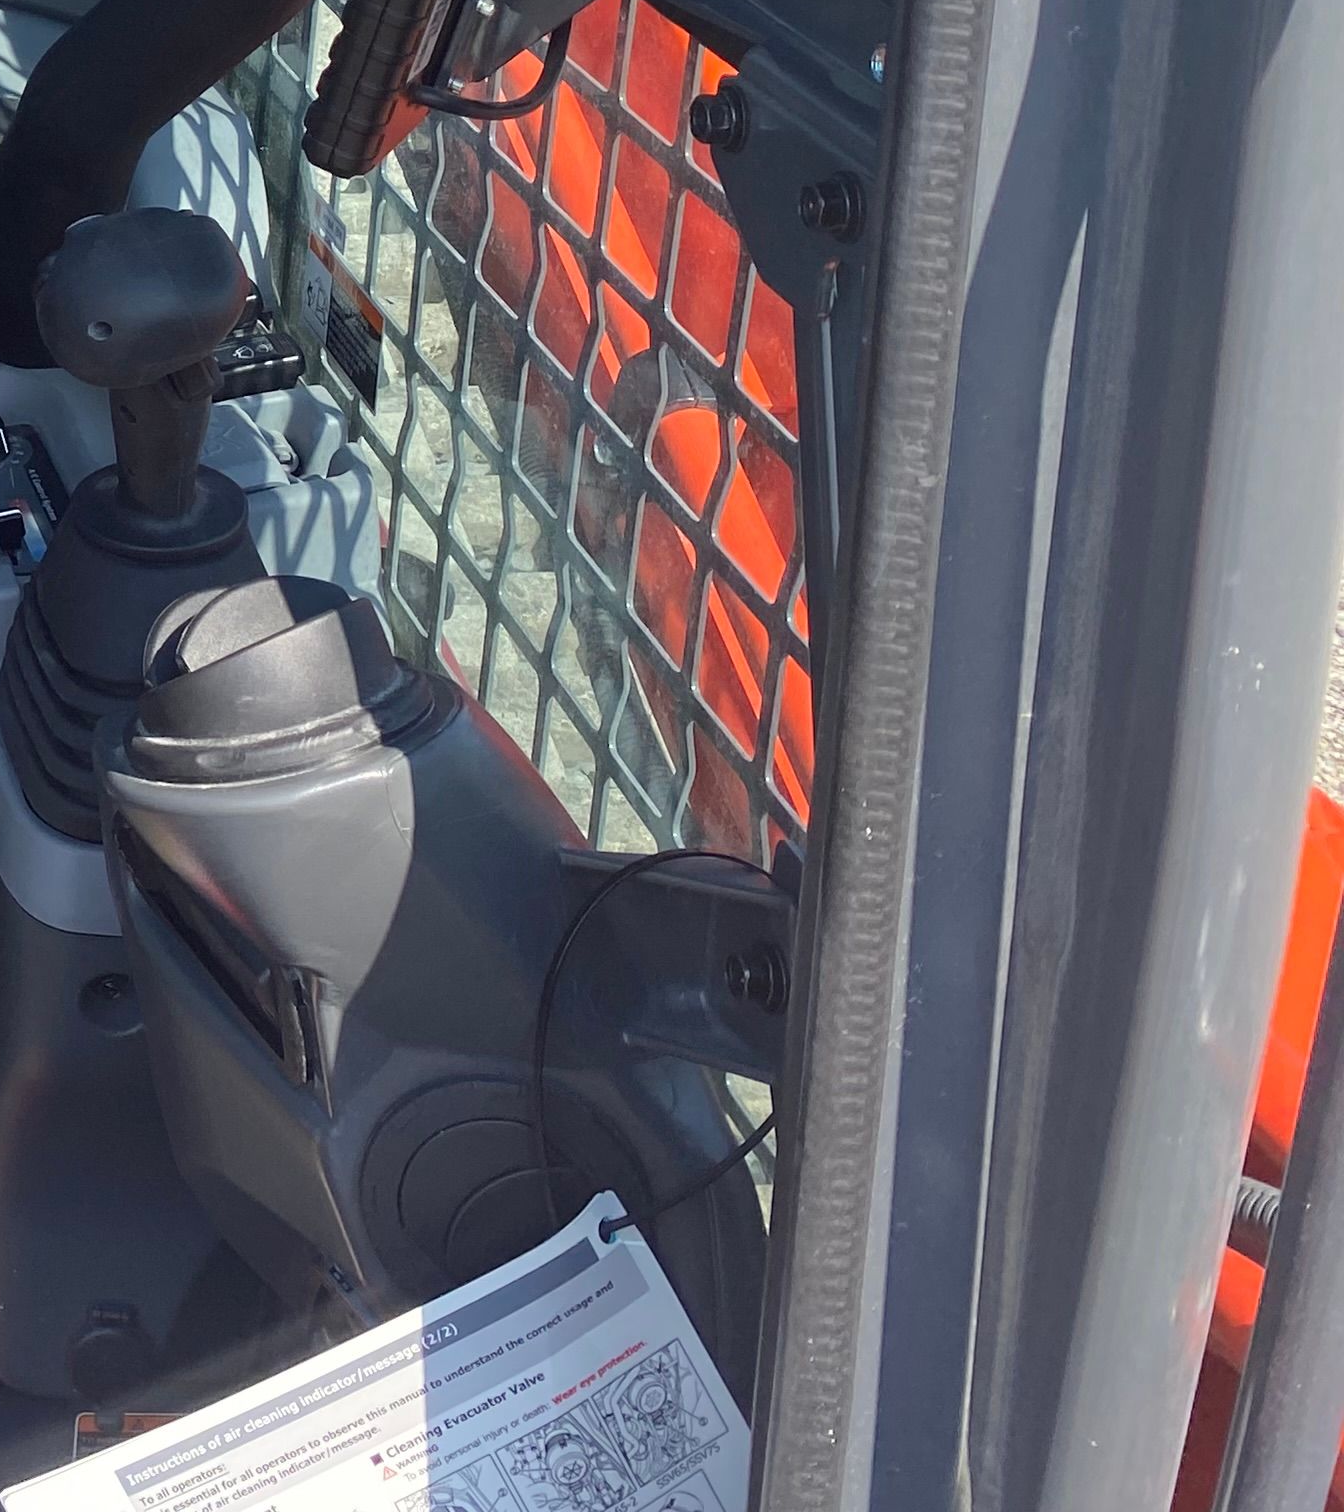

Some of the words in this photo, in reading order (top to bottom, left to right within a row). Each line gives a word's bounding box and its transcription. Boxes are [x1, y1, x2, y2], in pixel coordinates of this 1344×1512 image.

[126, 1443, 207, 1487] Instructions
[208, 1435, 223, 1450] of
[224, 1428, 242, 1443] air
[243, 1401, 301, 1433] cleaning
[299, 1343, 421, 1408] indicator/message
[421, 1322, 459, 1350] (2/2)
[172, 1483, 221, 1512] essential
[221, 1475, 239, 1491] for
[240, 1468, 255, 1483] all
[256, 1444, 308, 1476] operators
[308, 1438, 322, 1450] to
[322, 1415, 366, 1442] observe
[366, 1404, 388, 1422] this
[389, 1384, 430, 1411] manual
[430, 1377, 443, 1390] to
[444, 1345, 505, 1384] understand
[505, 1335, 525, 1352] the
[526, 1315, 562, 1341] correct
[564, 1296, 594, 1320] usage
[596, 1280, 615, 1298] and
[385, 1425, 443, 1458] Cleaning
[444, 1391, 507, 1430] Evacuator
[508, 1371, 546, 1396] Valve
[404, 1471, 417, 1482] To
[418, 1458, 443, 1476] avoid
[444, 1438, 482, 1465] personal
[483, 1425, 509, 1444] injury
[510, 1419, 520, 1429] or
[521, 1403, 552, 1423] death:
[551, 1386, 578, 1406] Wear
[578, 1373, 597, 1390] eye
[596, 1338, 648, 1379] protection.
[395, 1443, 440, 1470] WARNING
[656, 1443, 721, 1490] SSV65/SSV75
[139, 1496, 155, 1508] To
[156, 1487, 171, 1501] all
[214, 1495, 230, 1509] air
[232, 1475, 278, 1501] cleaning
